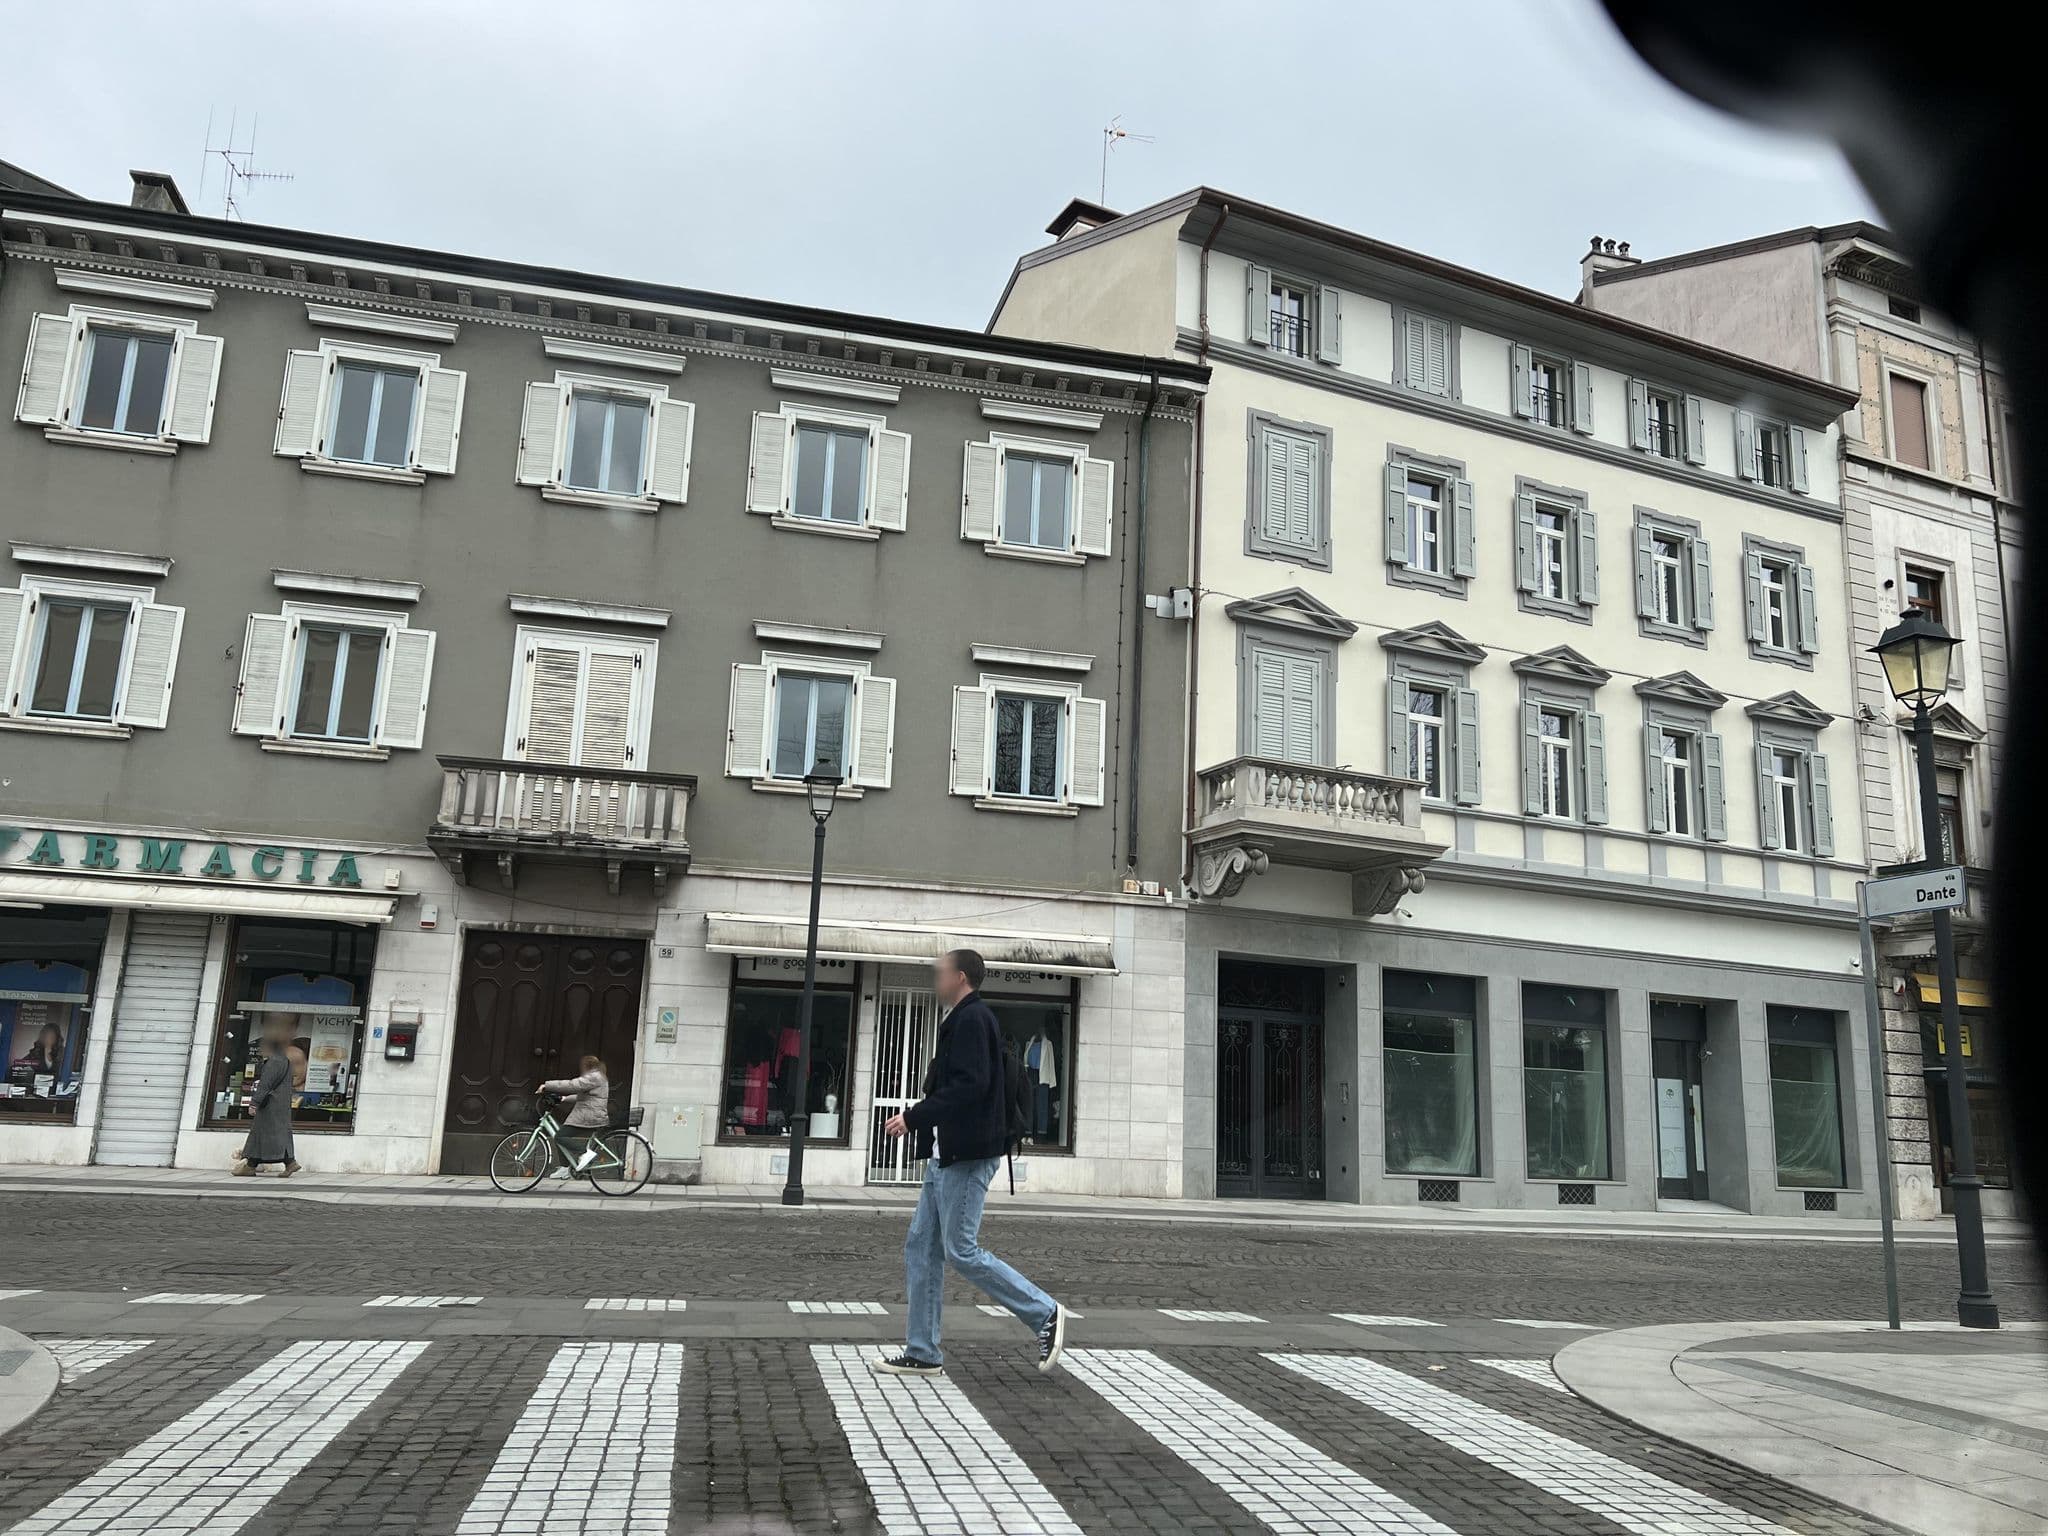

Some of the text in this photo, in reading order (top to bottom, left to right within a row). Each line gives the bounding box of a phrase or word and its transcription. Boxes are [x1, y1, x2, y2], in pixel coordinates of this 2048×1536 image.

[1916, 886, 1956, 902] Dante
[1004, 970, 1032, 982] good
[317, 1017, 353, 1026] VICHY
